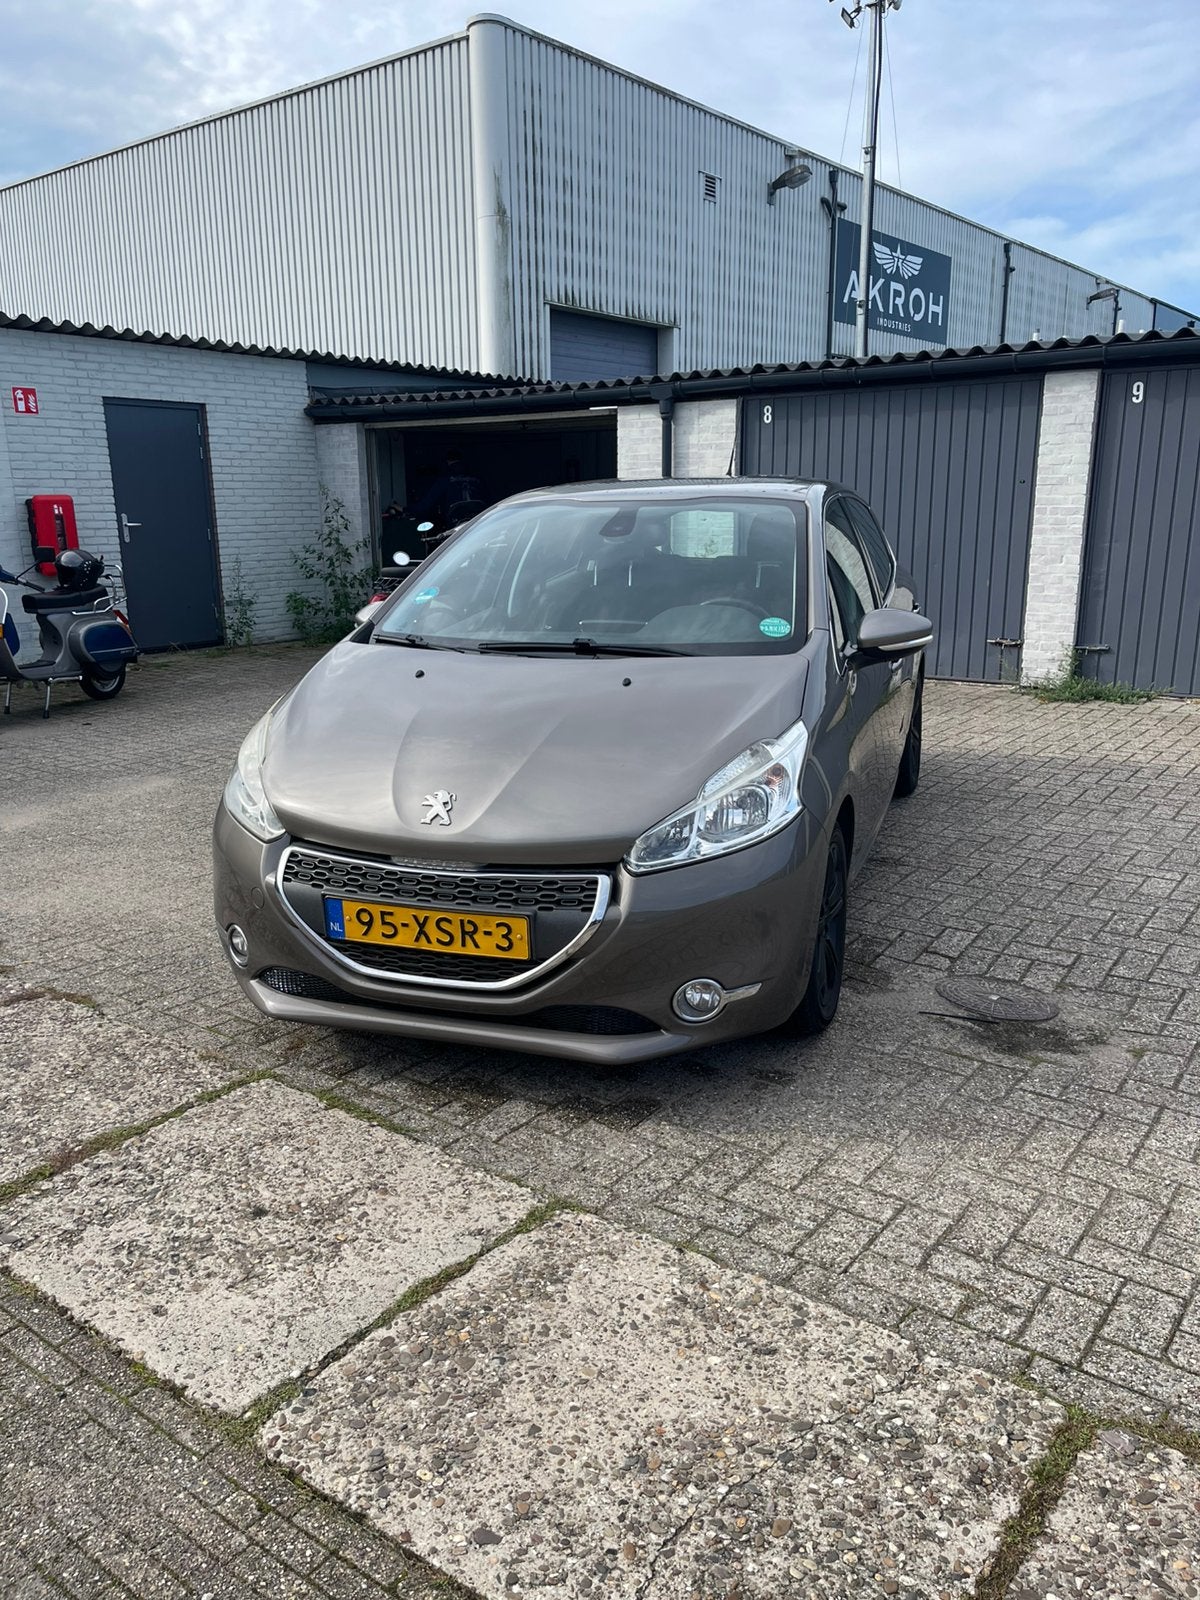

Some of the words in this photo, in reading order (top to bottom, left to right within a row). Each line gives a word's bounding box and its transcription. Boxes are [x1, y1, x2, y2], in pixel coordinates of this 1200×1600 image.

[843, 269, 944, 326] AKROH
[876, 317, 911, 332] INDUSTRIES
[1131, 381, 1144, 404] 9
[763, 405, 773, 424] 8
[330, 921, 343, 932] NL
[355, 907, 514, 952] 95-XSR-3
